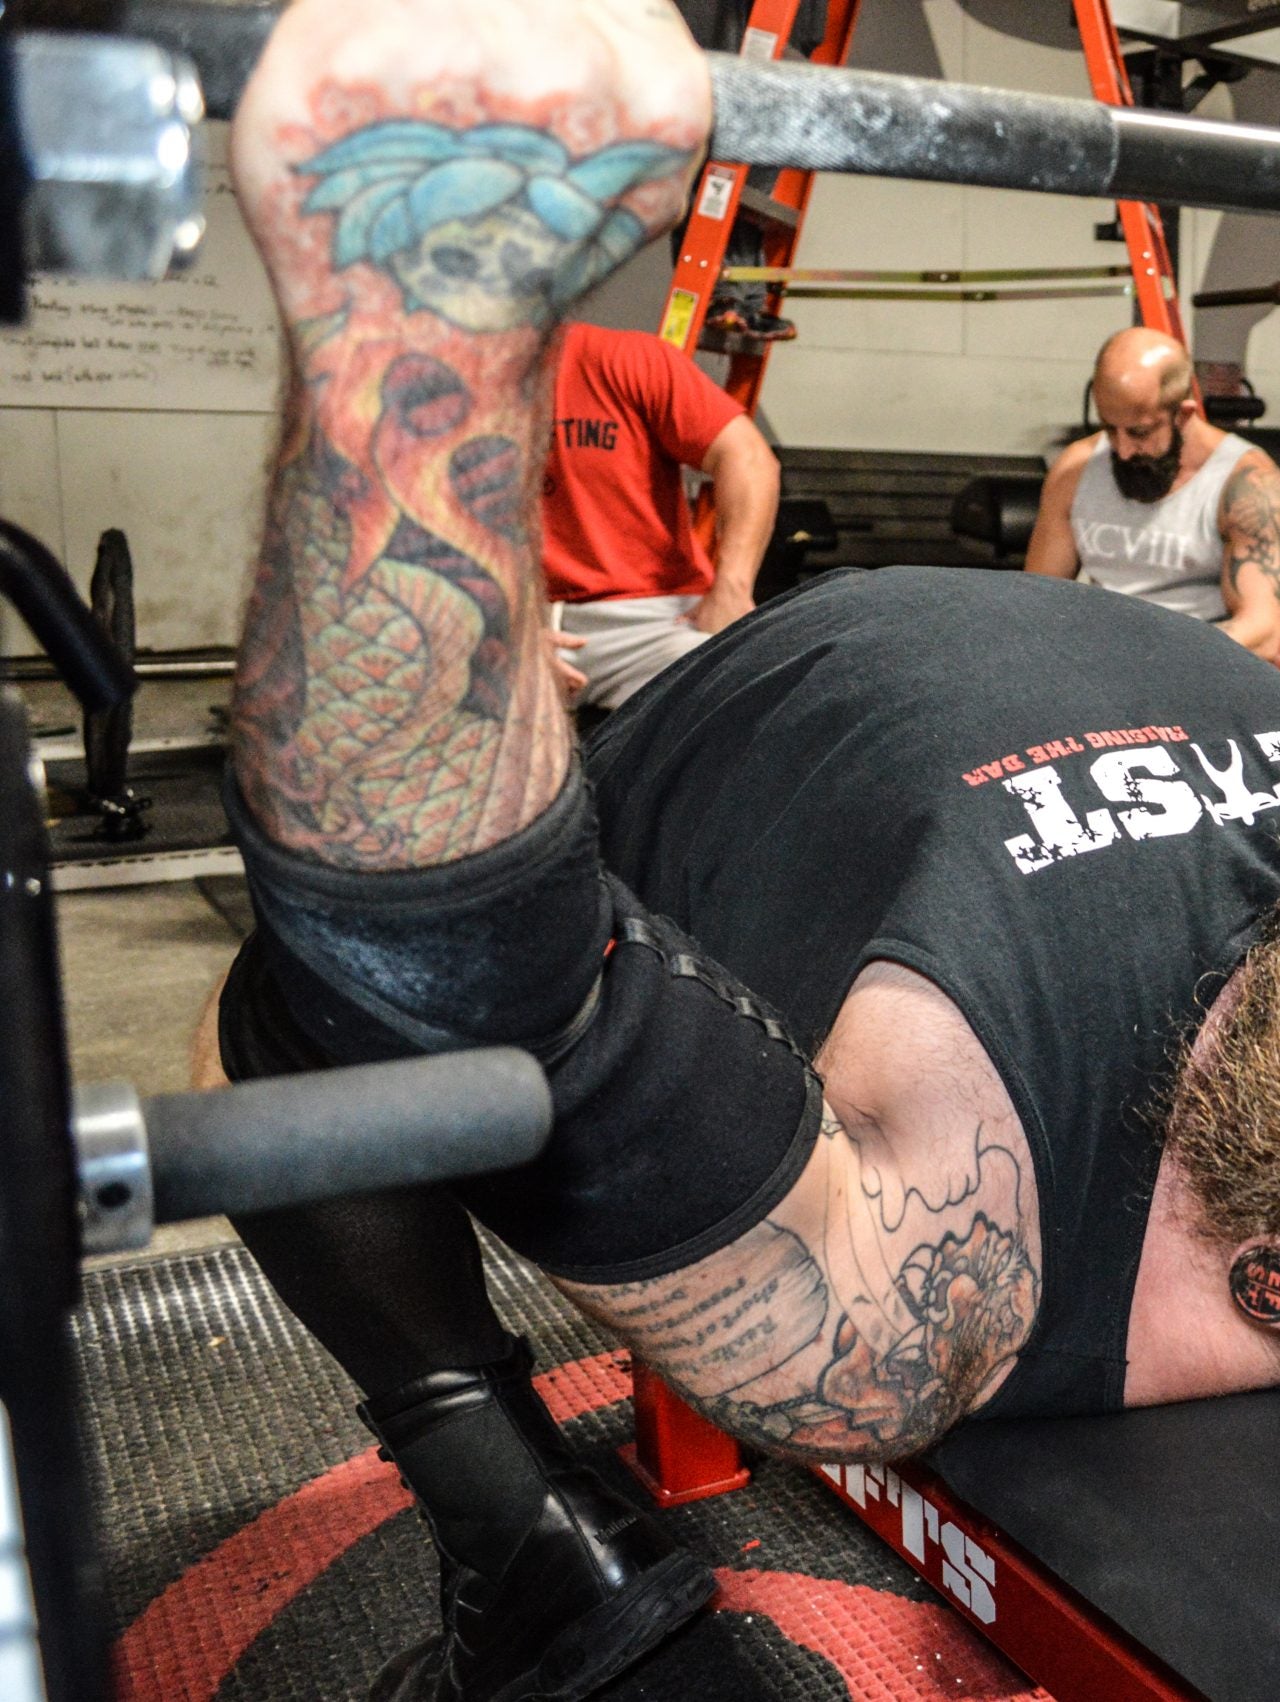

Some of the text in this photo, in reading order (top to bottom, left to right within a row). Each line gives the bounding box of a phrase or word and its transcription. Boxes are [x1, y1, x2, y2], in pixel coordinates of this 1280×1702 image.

[561, 418, 619, 450] TING
[962, 725, 1190, 787] RAISING THE BAR
[820, 1463, 997, 1625] FTS
